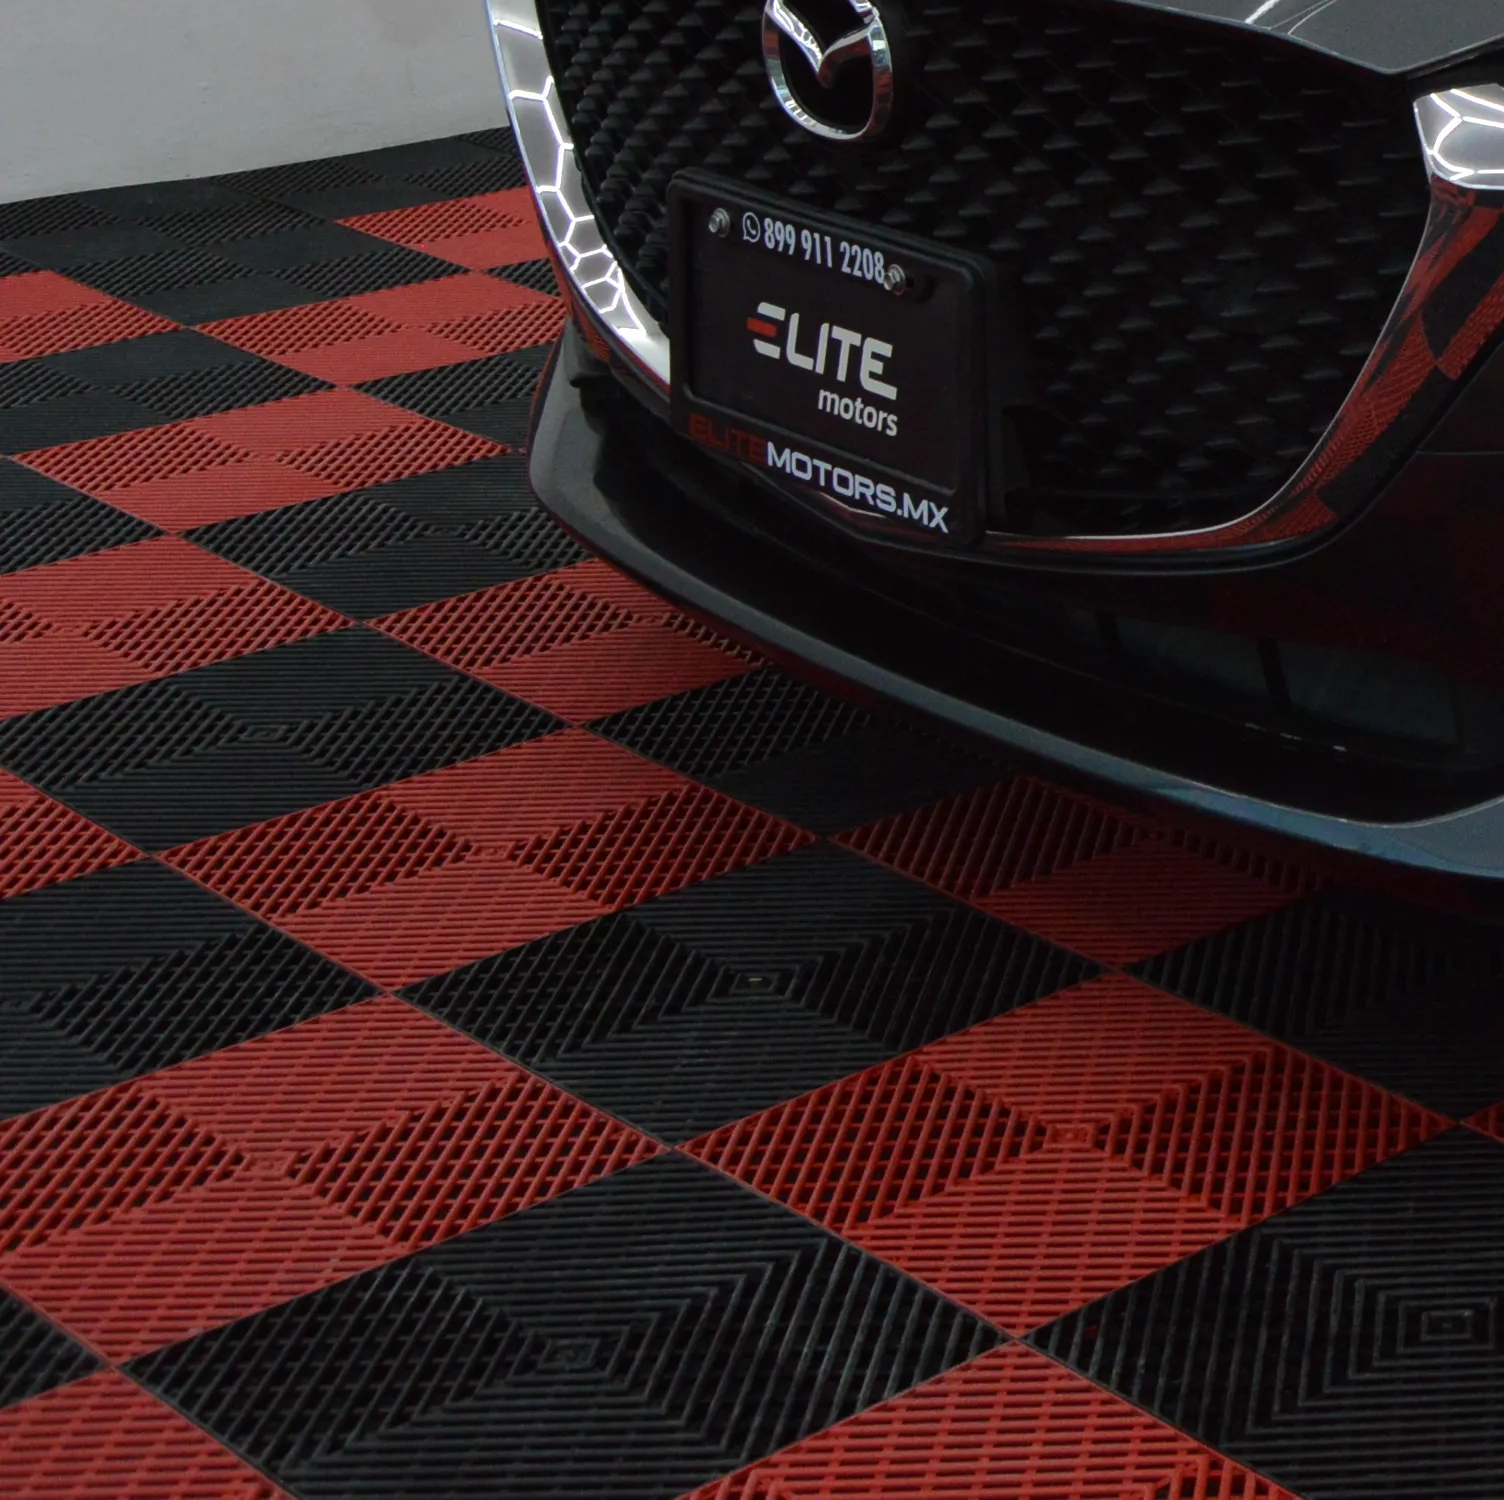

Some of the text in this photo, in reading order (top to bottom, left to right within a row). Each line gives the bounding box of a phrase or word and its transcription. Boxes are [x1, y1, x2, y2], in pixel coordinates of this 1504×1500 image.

[763, 217, 885, 284] 899 911 2208
[746, 301, 898, 400] ELITE
[818, 388, 898, 437] motors
